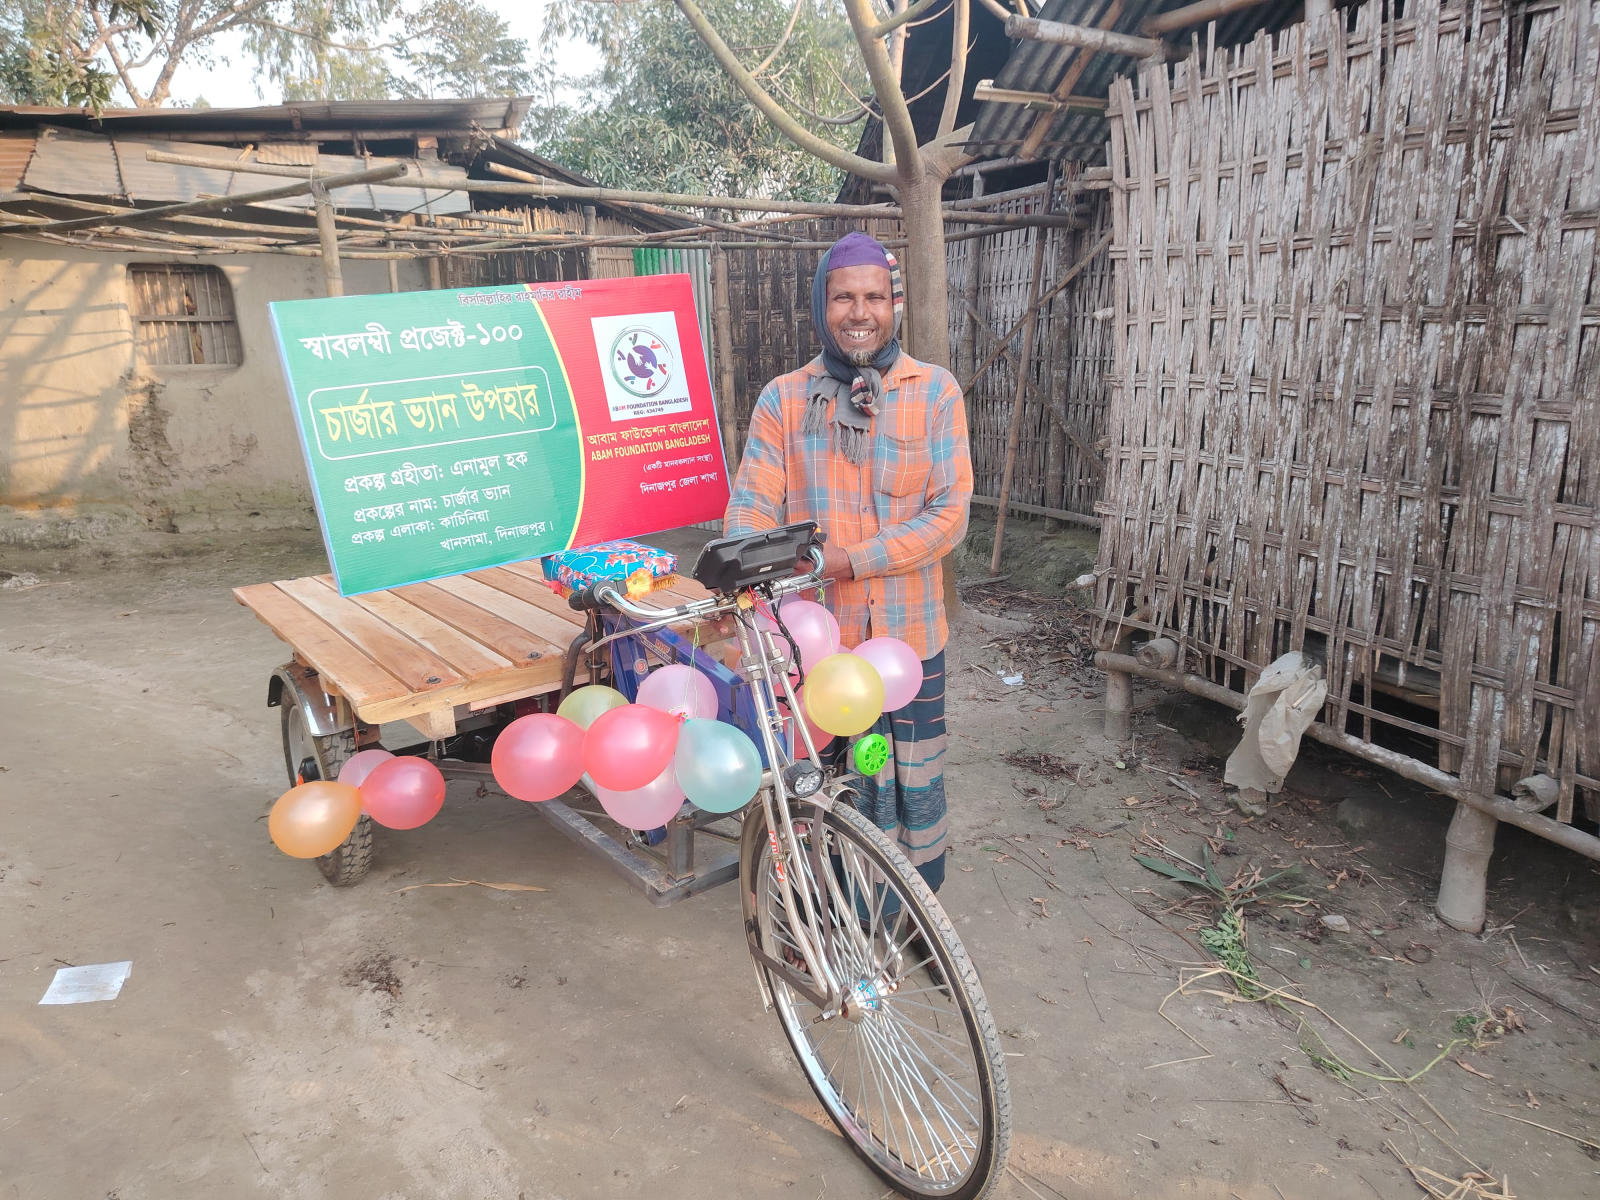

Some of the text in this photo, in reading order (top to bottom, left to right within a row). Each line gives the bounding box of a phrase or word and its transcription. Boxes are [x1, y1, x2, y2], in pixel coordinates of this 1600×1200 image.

[298, 318, 523, 360] স্বাবলম্বী প্রজেক্ট-১০০
[319, 379, 541, 443] চার্জার ভ্যান উপহার
[586, 418, 710, 446] আবাম ফাউন্ডেশন বাংলাদেশ
[591, 433, 711, 461] ABAM FOUNDATION BANGLADESH
[344, 451, 528, 494] প্রকল্প গ্রহীতা: এনামুল হক
[640, 472, 718, 495] দিনাজপুর জেলা শাখা
[353, 483, 512, 524] প্রকল্পের নাম: চার্জার ভ্যান
[351, 508, 490, 545] প্রকল্প এলাকা: কাচিনিয়া
[440, 532, 493, 551] খানসামা,
